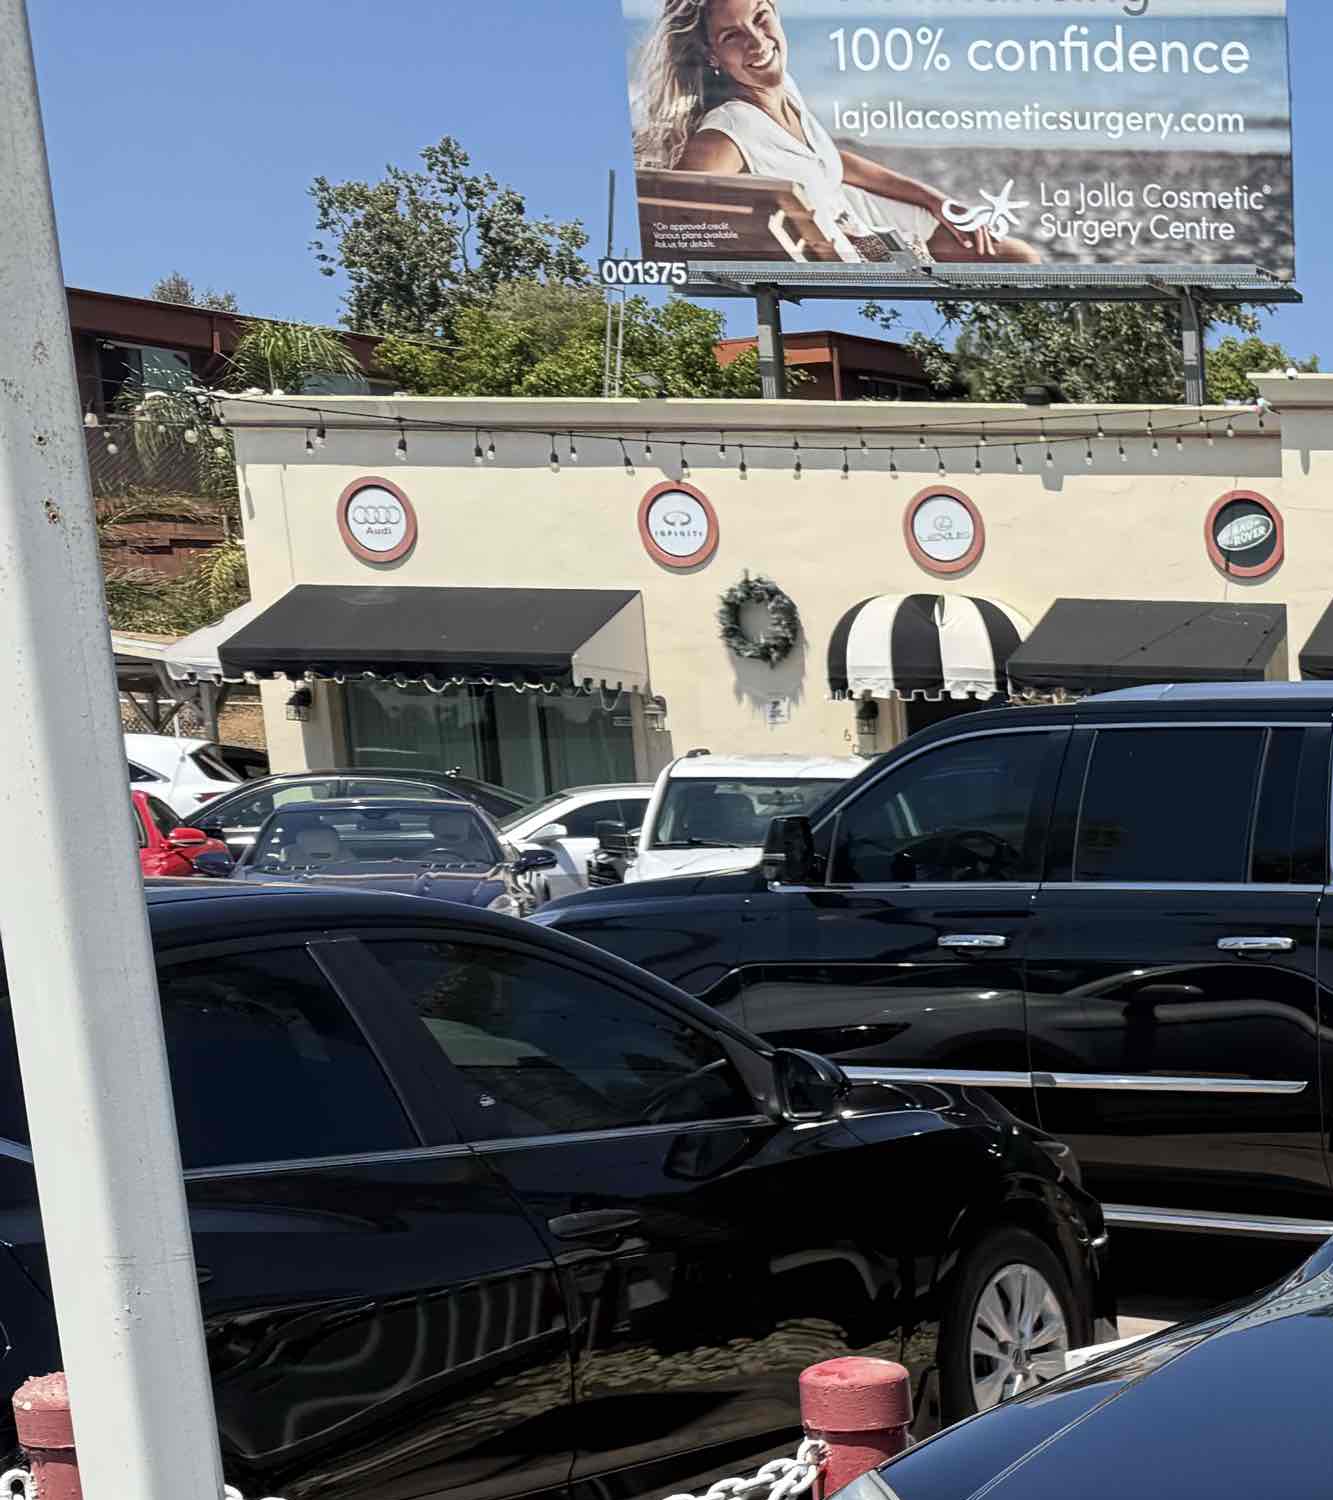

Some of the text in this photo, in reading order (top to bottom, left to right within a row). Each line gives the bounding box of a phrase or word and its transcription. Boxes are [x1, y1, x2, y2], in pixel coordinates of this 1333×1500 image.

[828, 24, 1250, 74] 100% confidence
[833, 100, 1246, 140] lajollacosmeticsurgery.com
[1039, 181, 1070, 207] La
[1075, 182, 1134, 215] Jolla
[1039, 212, 1236, 246] Surgery Centre
[601, 260, 688, 285] 001375
[366, 526, 392, 535] Audi
[1232, 525, 1267, 546] ROVER
